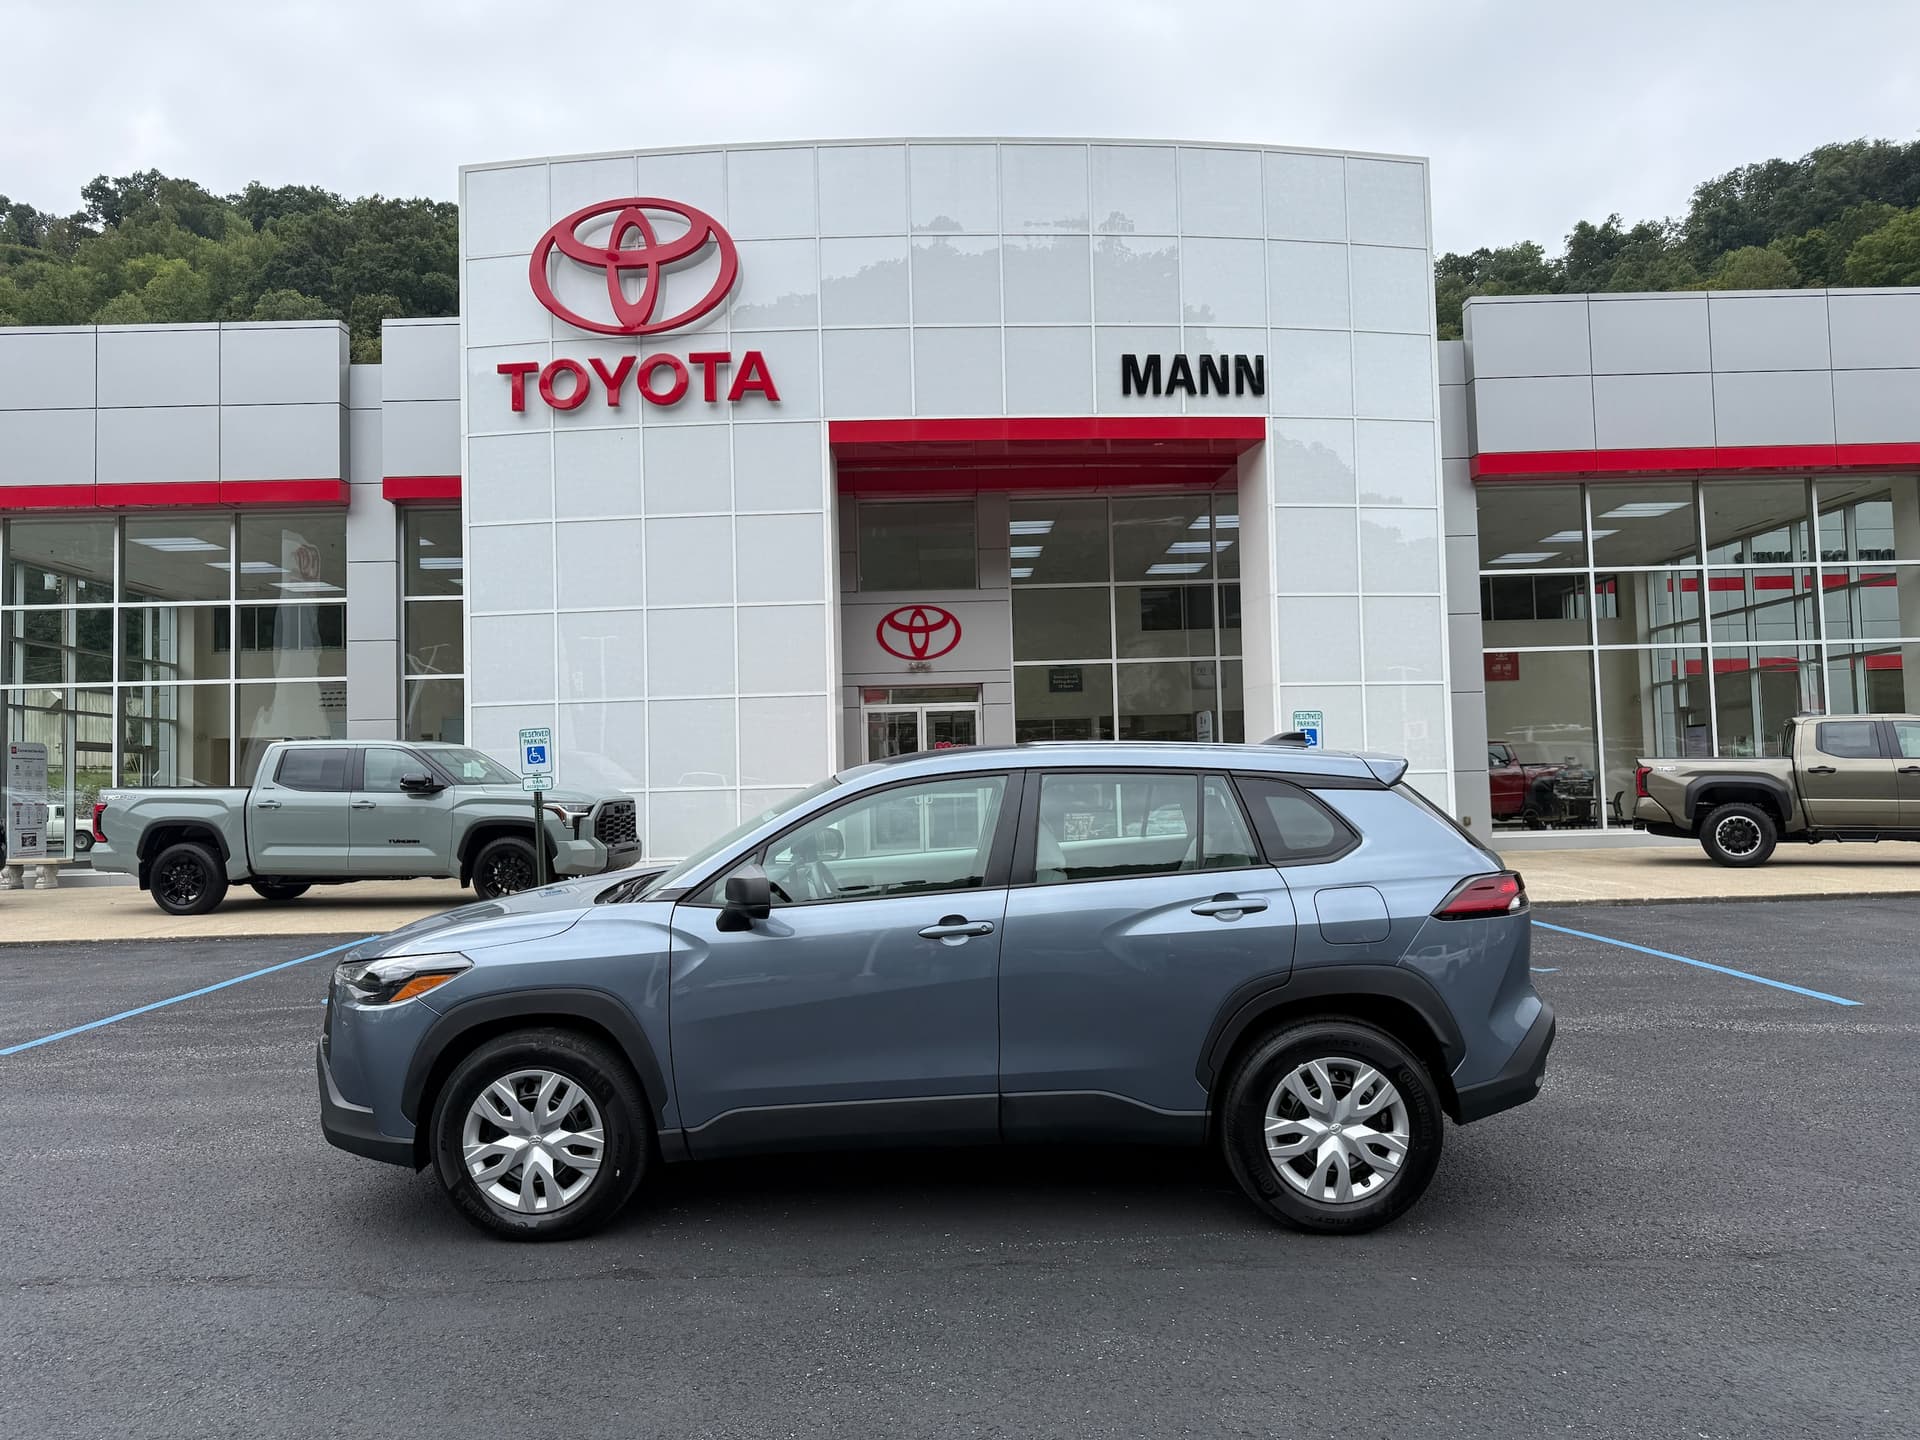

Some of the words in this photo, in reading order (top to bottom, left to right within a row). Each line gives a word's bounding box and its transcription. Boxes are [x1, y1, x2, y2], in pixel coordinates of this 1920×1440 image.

[497, 350, 780, 412] TOYOTA
[1121, 354, 1265, 396] MANN
[523, 737, 548, 745] PARKING
